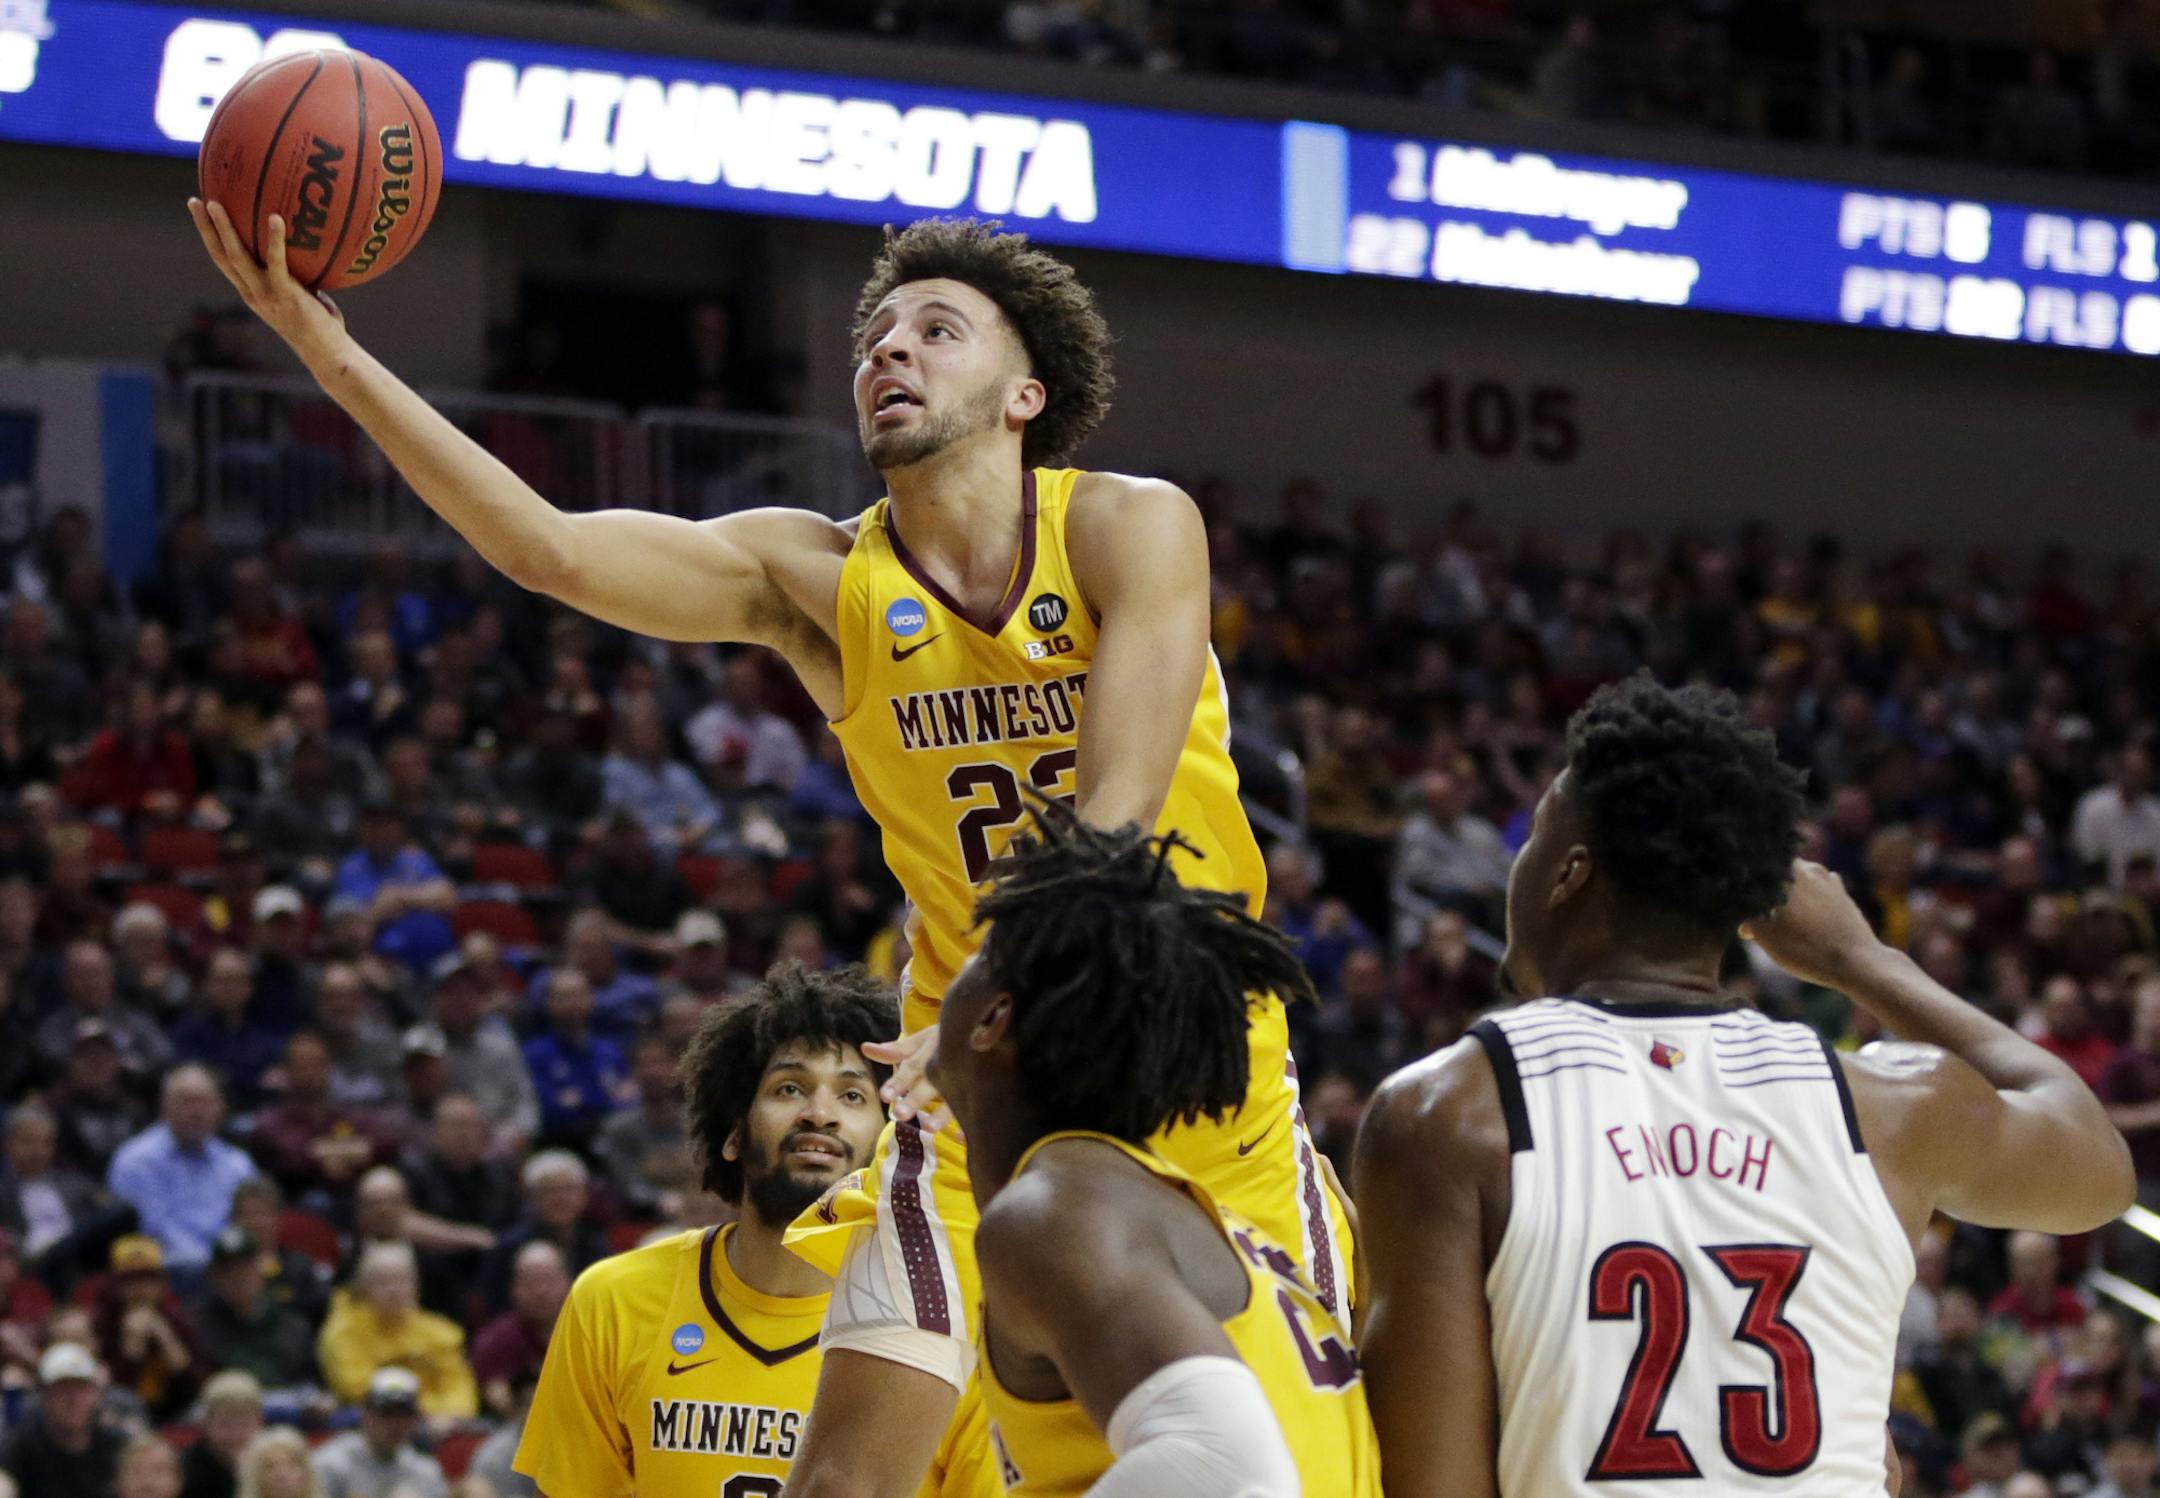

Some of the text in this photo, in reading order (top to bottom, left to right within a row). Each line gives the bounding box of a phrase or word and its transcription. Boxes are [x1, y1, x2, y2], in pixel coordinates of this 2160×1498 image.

[455, 58, 1098, 223] MINNESOTA
[286, 134, 345, 252] NCAA
[346, 121, 414, 275] Wilson
[1409, 375, 1581, 464] 105
[891, 613, 924, 628] NCAA
[1032, 599, 1063, 627] TM
[1605, 1122, 1774, 1192] ENOCH
[1585, 1241, 1822, 1482] 23
[651, 1398, 808, 1461] MINNES
